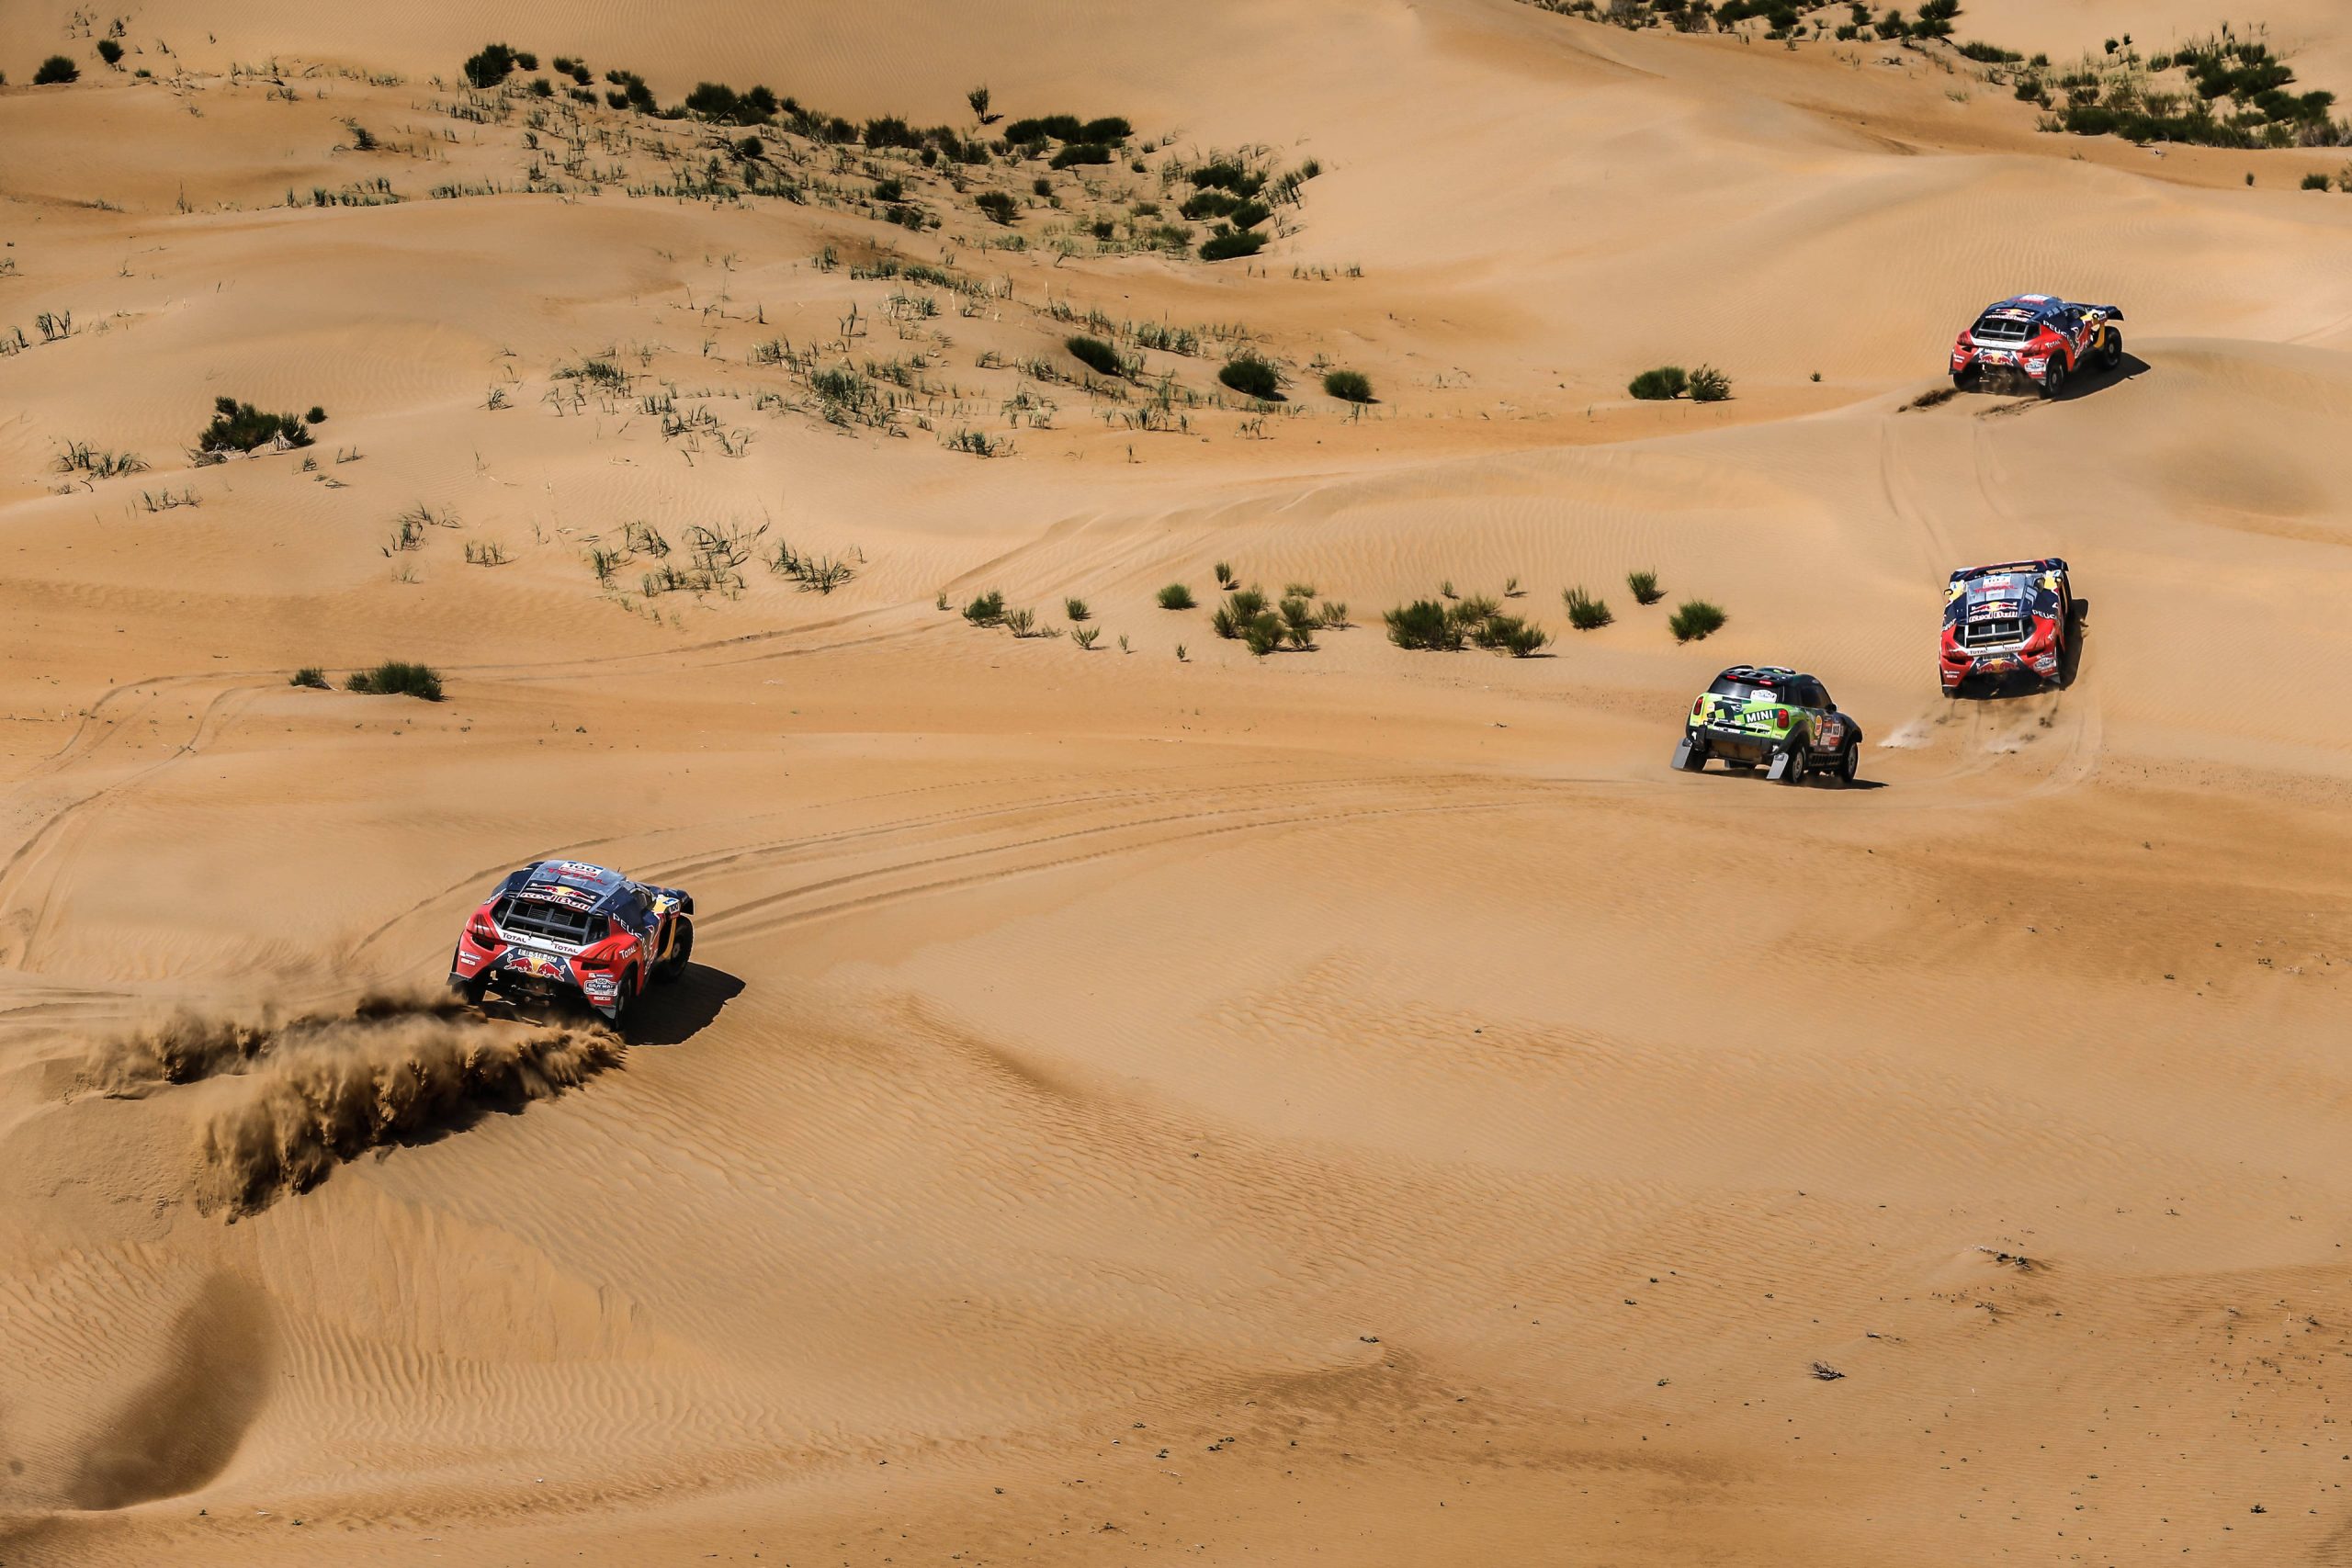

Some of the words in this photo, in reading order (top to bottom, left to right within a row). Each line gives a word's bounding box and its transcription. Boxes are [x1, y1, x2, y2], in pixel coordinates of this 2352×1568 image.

[1746, 709, 1773, 723] MINI
[519, 892, 557, 903] Red
[554, 896, 592, 912] Bull
[502, 932, 527, 943] TOTAL
[553, 943, 580, 953] TOTAL
[618, 945, 637, 960] TOTAL
